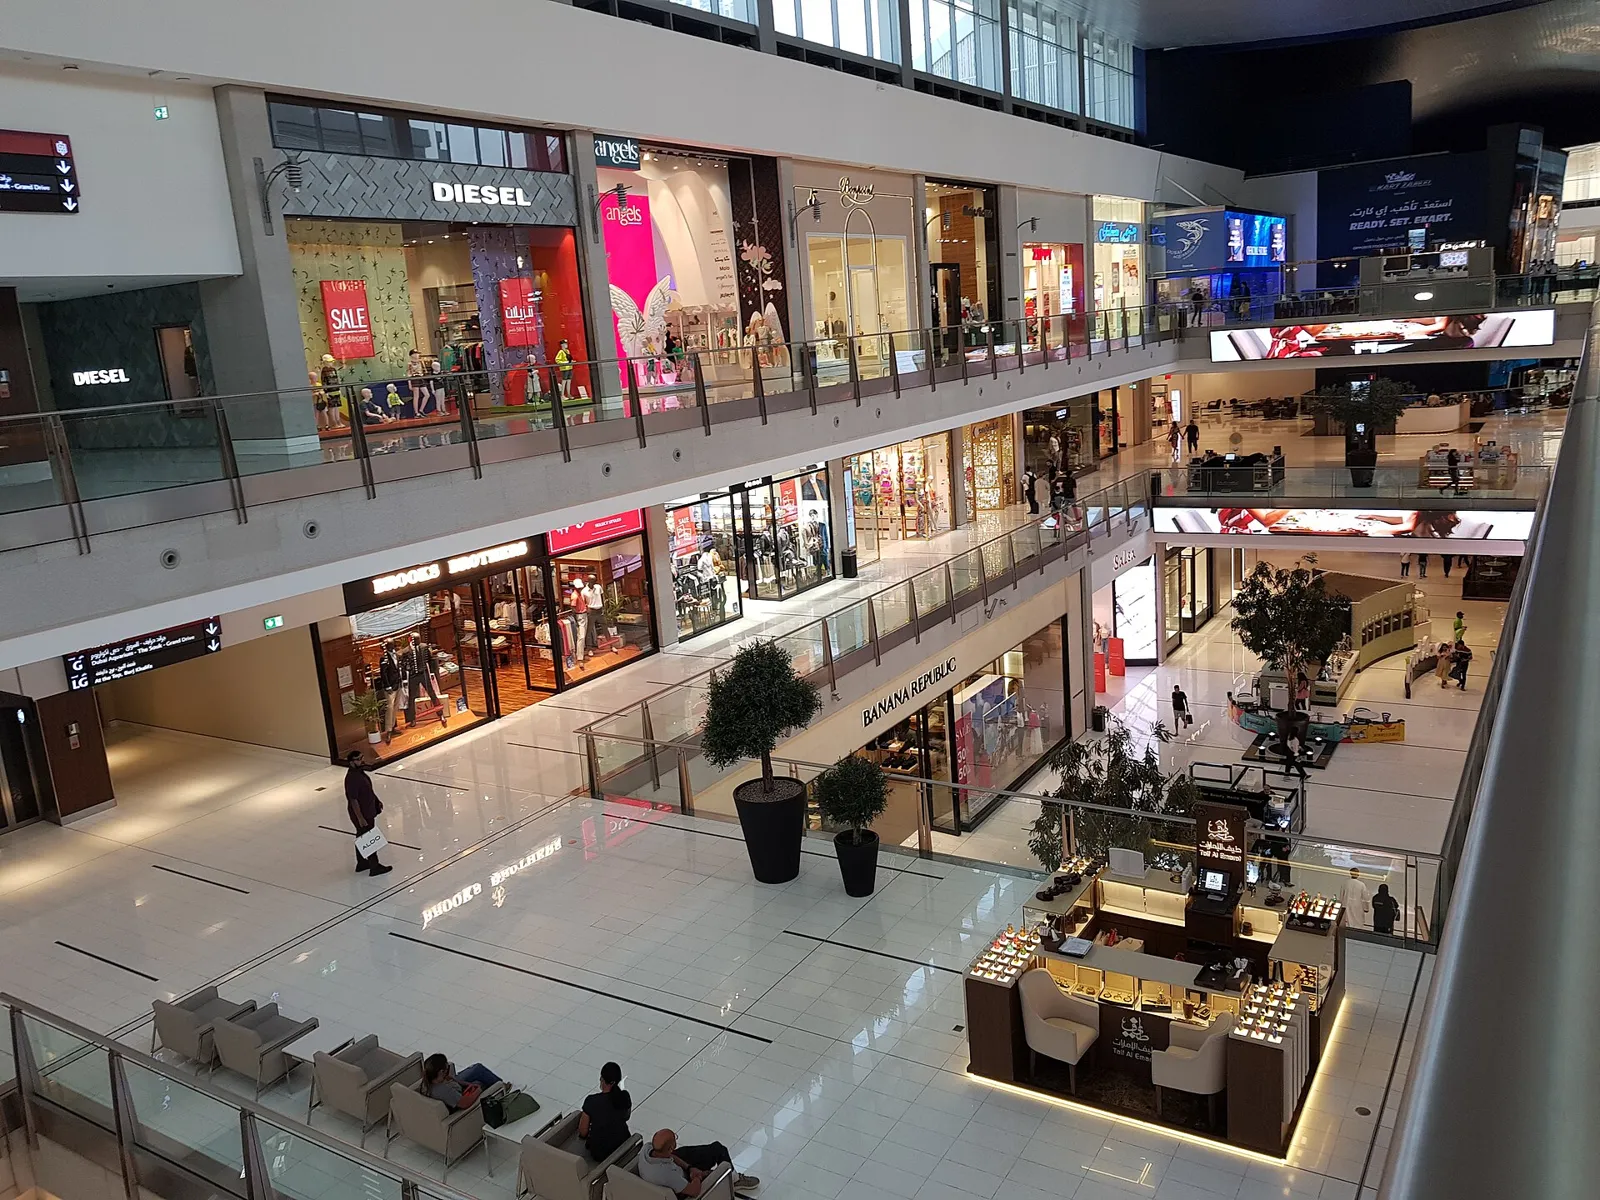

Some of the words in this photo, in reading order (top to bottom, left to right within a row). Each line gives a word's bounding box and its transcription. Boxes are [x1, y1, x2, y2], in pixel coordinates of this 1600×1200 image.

[594, 139, 639, 164] angels
[432, 182, 532, 207] DIESEL
[605, 205, 642, 226] angels
[1349, 219, 1388, 231] READY.
[1389, 217, 1412, 227] SET.
[1413, 212, 1454, 224] EKART.
[331, 308, 368, 330] SALE
[505, 305, 534, 320] تنزيلات
[73, 368, 130, 386] DIESEL
[678, 517, 690, 525] SALE
[372, 563, 441, 595] BROOKS
[447, 540, 528, 574] BROTHERS
[91, 657, 108, 666] Dubai
[108, 651, 134, 663] Aquarium
[138, 646, 149, 654] The
[149, 643, 162, 652] Souk
[166, 639, 181, 647] Grand
[182, 635, 195, 643] Drive
[72, 660, 83, 671] G
[124, 668, 135, 677] Burj
[135, 664, 153, 673] Khalifa
[72, 677, 89, 690] LG
[862, 686, 910, 728] BANANA
[909, 656, 957, 697] REPUBLIC
[955, 723, 971, 741] SALE
[362, 835, 381, 850] ALDO
[1112, 1047, 1125, 1055] Taif
